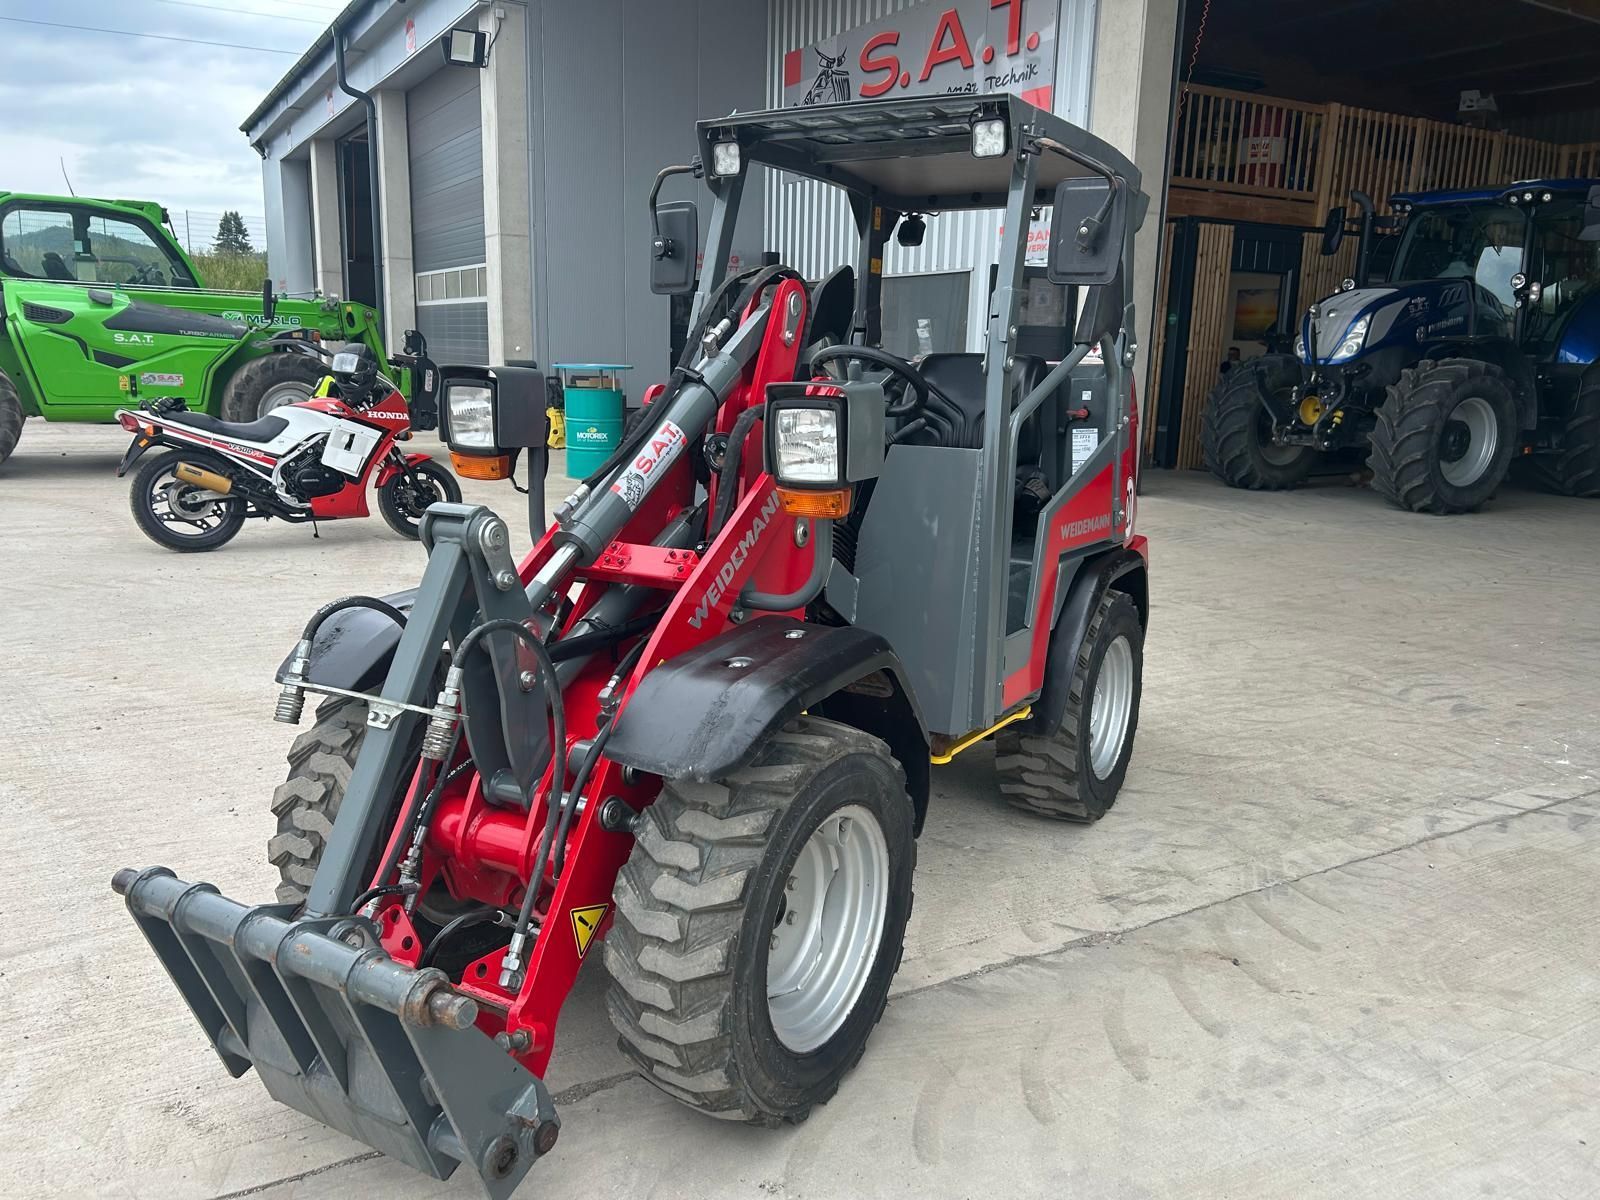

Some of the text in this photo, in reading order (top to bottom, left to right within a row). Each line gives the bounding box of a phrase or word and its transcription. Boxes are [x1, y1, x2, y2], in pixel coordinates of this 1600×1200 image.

[858, 0, 1040, 97] S.A.T.
[985, 63, 1038, 89] Technik
[114, 333, 154, 343] S.A.T.
[367, 410, 409, 420] HONDA
[576, 432, 608, 440] MOTOREX
[635, 422, 680, 475] S.A.T.
[1060, 513, 1110, 541] WEIDEMANN
